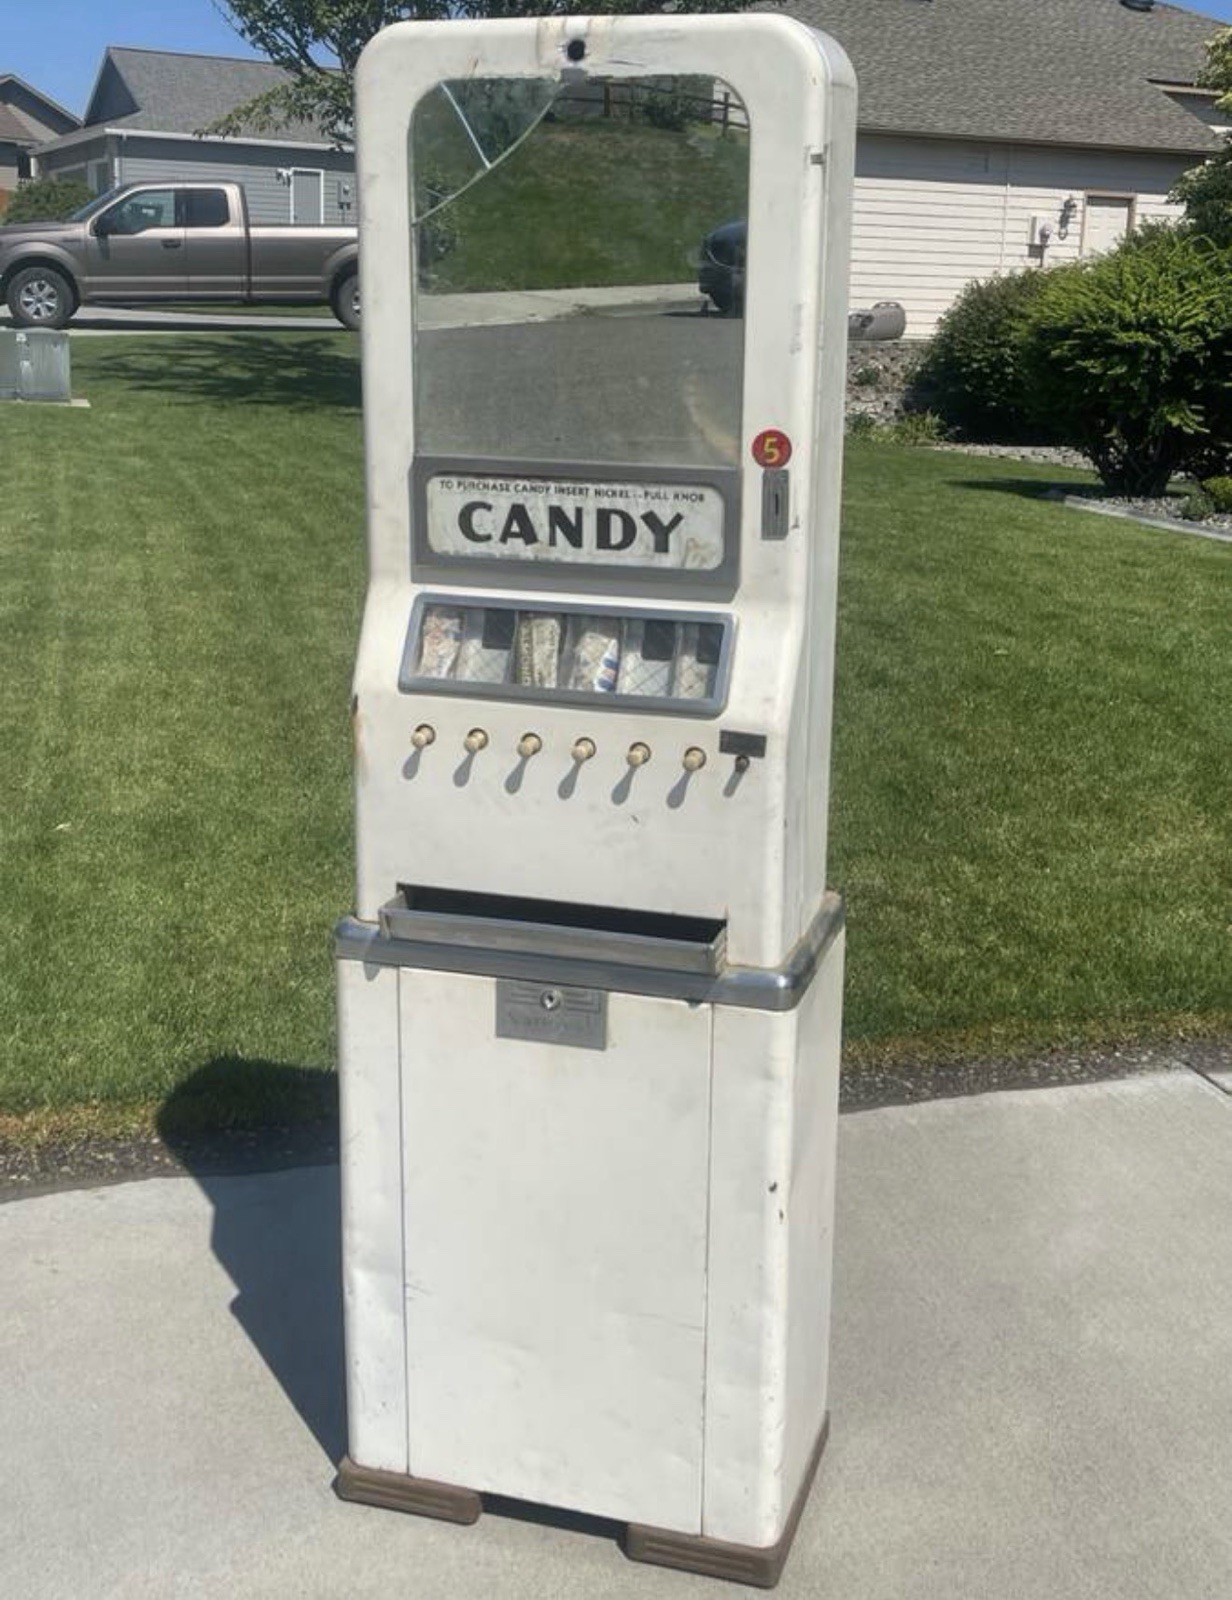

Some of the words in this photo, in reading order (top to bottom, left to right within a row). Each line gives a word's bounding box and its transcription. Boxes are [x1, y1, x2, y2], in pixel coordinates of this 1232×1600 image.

[763, 437, 780, 464] 5
[440, 480, 454, 490] TO
[457, 480, 510, 493] PURCHASE
[514, 483, 550, 494] CANDY
[554, 486, 589, 496] INSERT
[457, 500, 684, 554] CANDY
